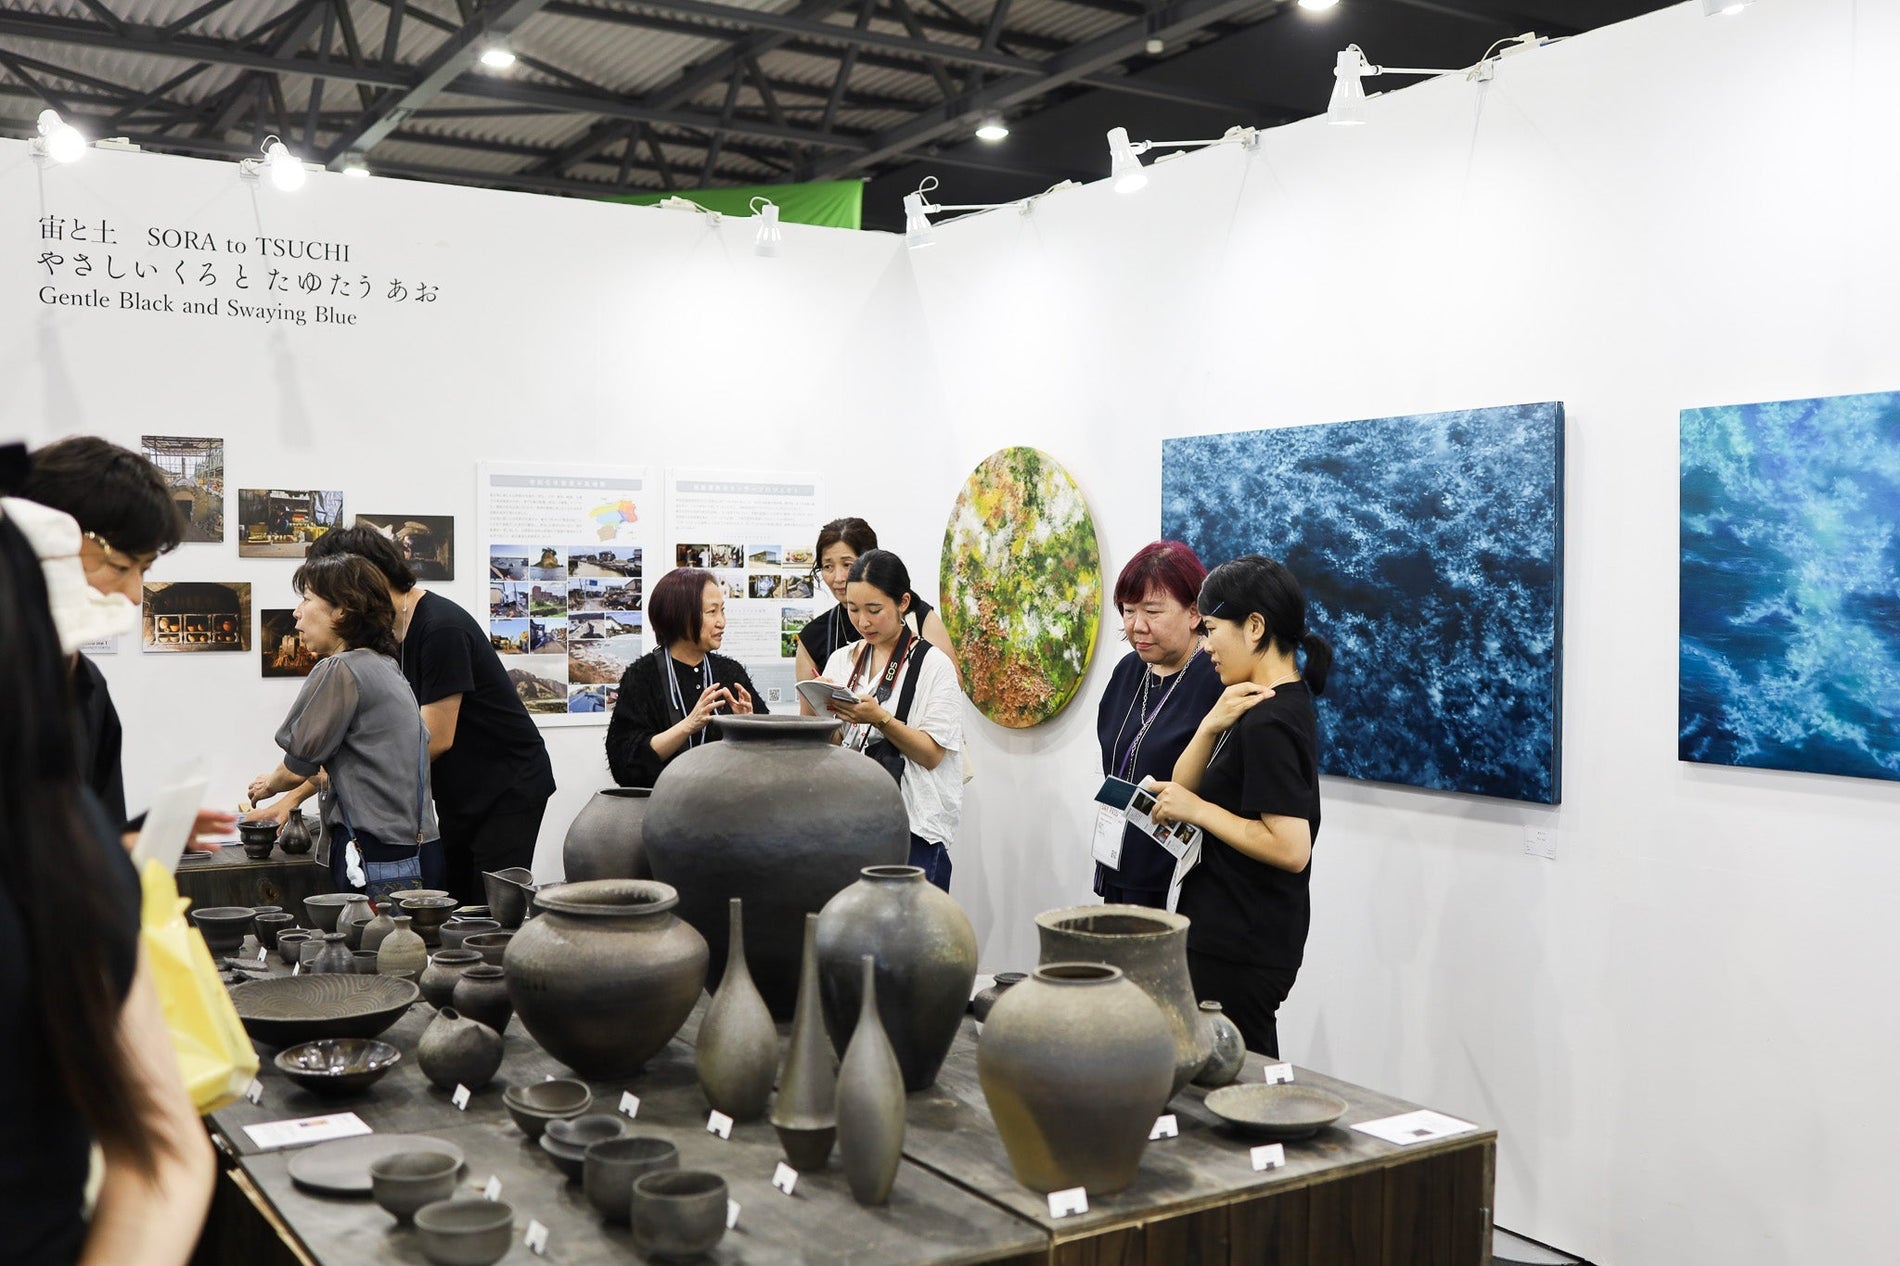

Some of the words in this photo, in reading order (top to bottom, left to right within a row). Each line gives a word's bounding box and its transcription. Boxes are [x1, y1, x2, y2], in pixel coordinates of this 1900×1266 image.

[38, 214, 118, 246] 宙と土
[147, 227, 217, 252] SORA
[227, 238, 247, 255] to
[255, 236, 350, 263] TSUCHI
[38, 285, 110, 310] Gentle
[119, 291, 174, 314] Black
[182, 298, 218, 316] and
[227, 298, 307, 326] Swaying
[315, 305, 357, 326] Blue
[885, 661, 898, 682] EOS
